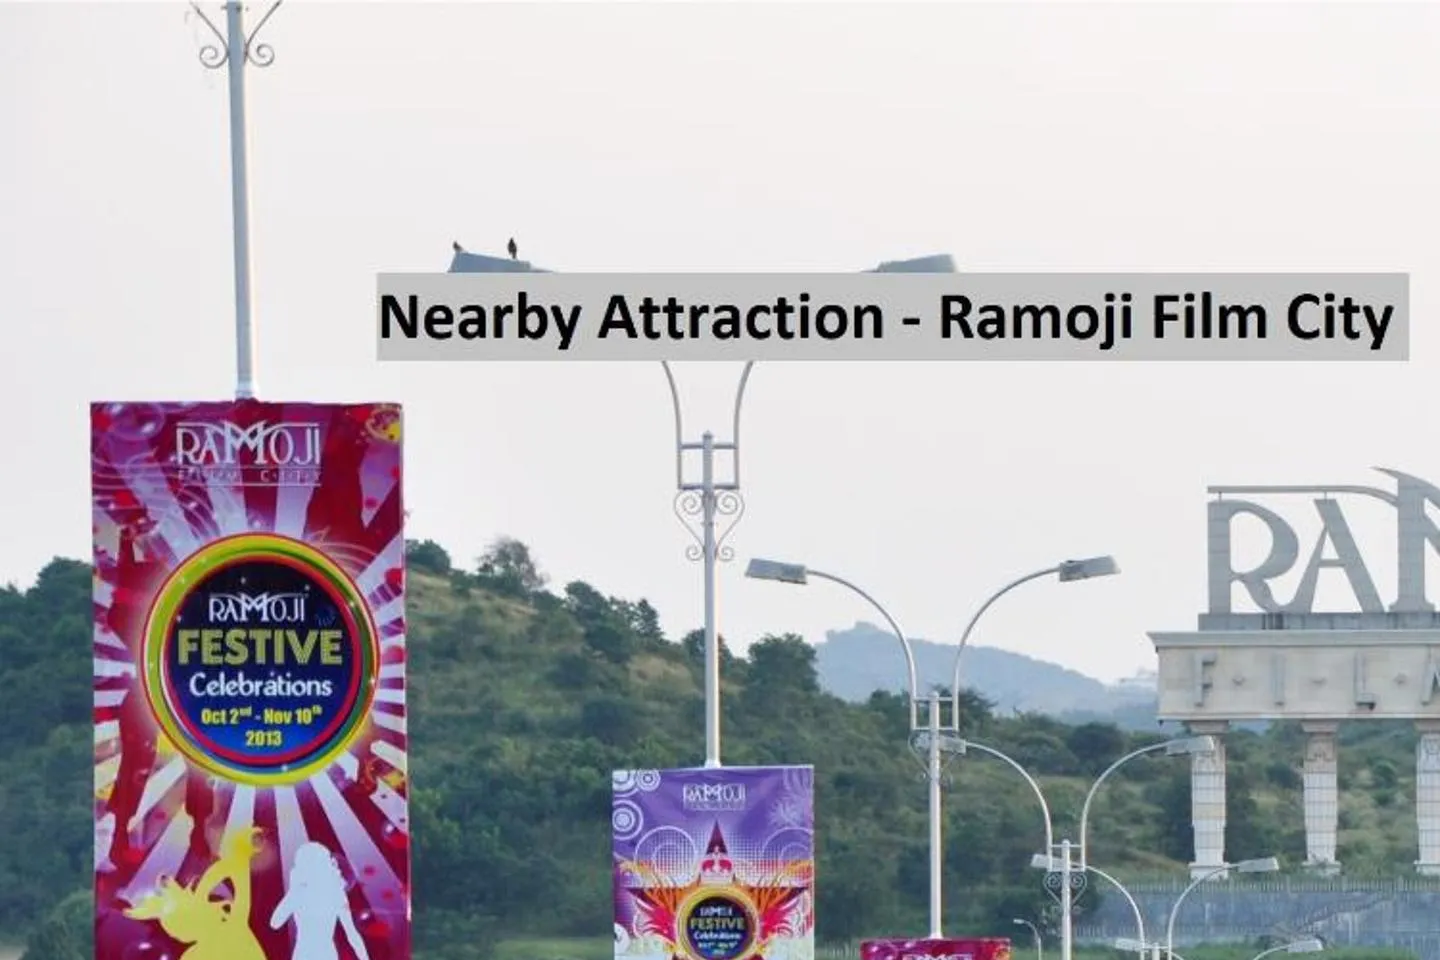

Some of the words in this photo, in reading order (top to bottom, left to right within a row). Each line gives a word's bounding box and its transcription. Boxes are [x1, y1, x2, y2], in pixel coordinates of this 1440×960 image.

[175, 420, 321, 465] RAMOJI
[208, 592, 305, 622] RAMOJI
[178, 629, 342, 665] FESTIVE
[189, 671, 333, 697] Celebrations
[201, 709, 226, 724] Oct
[264, 708, 292, 724] Nov
[245, 730, 282, 746] 2013
[690, 918, 745, 930] FESTIVE
